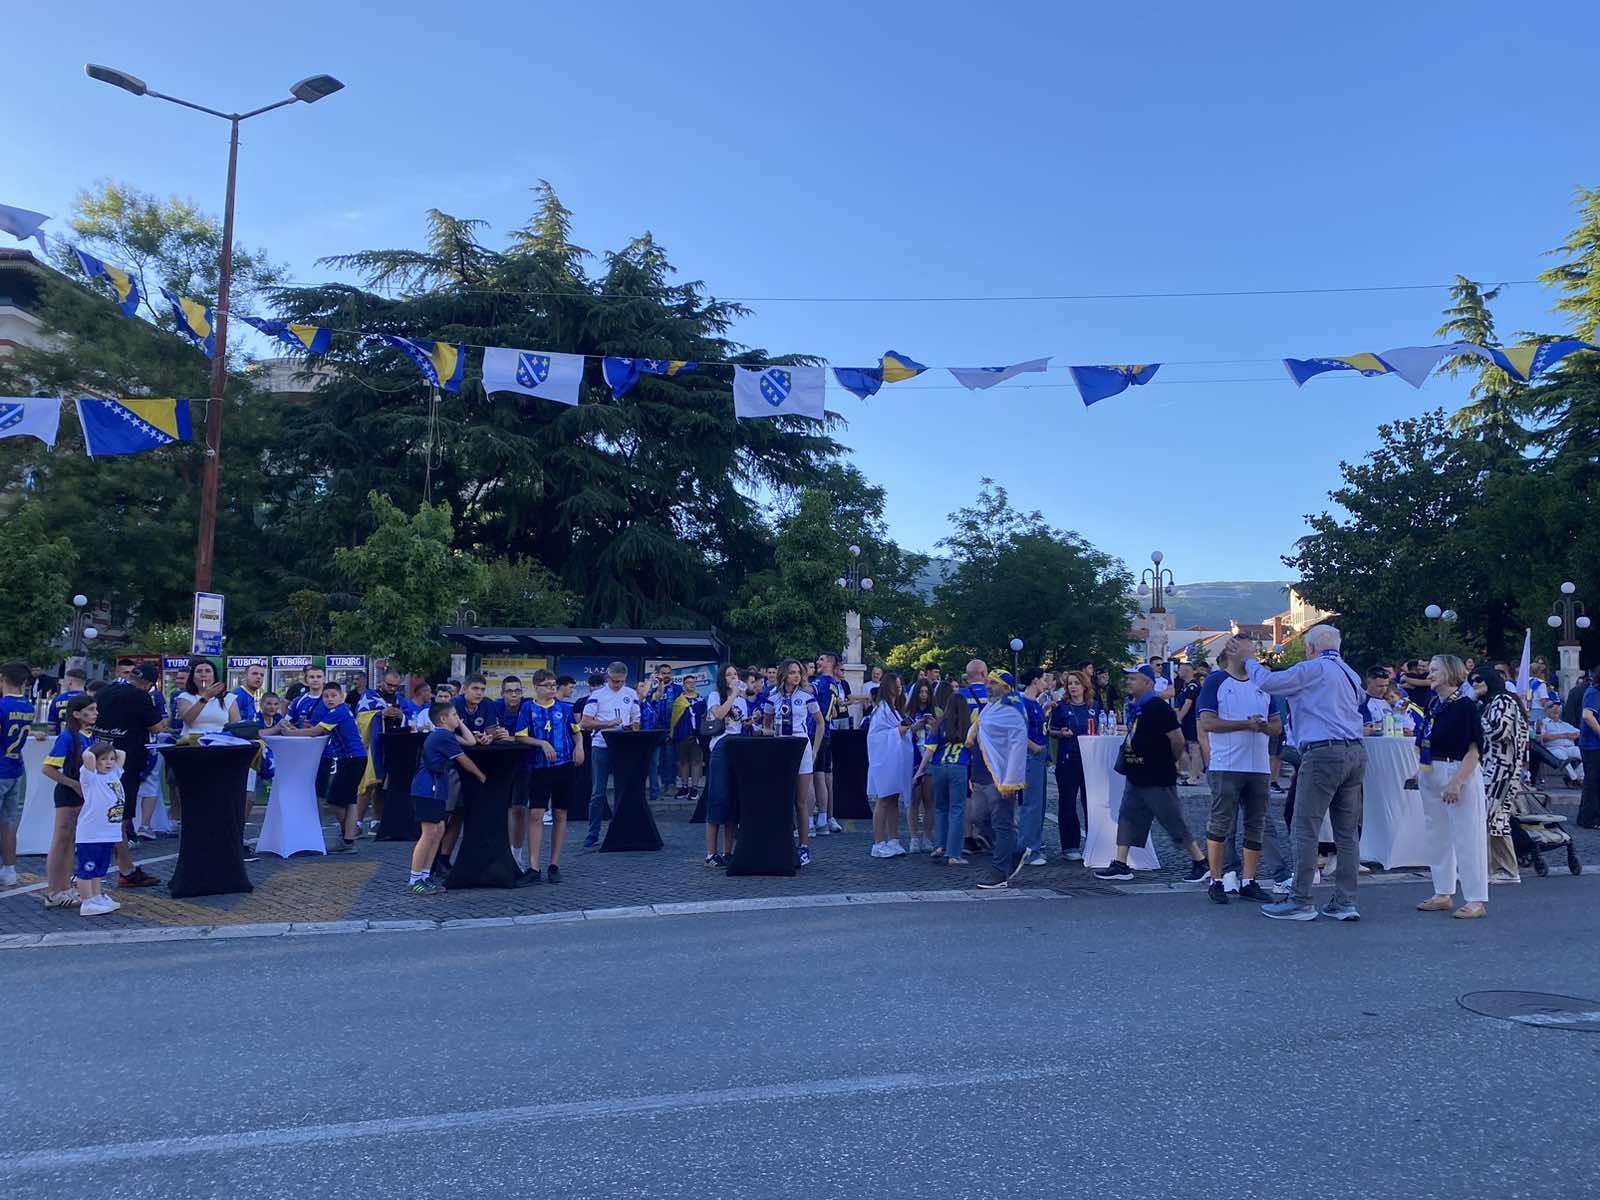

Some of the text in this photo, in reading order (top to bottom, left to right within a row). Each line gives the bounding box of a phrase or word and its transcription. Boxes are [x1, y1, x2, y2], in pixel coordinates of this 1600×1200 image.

[167, 658, 189, 667] TUBO
[276, 657, 308, 666] TUBORG
[330, 657, 361, 666] TUBORG
[544, 720, 552, 732] 4
